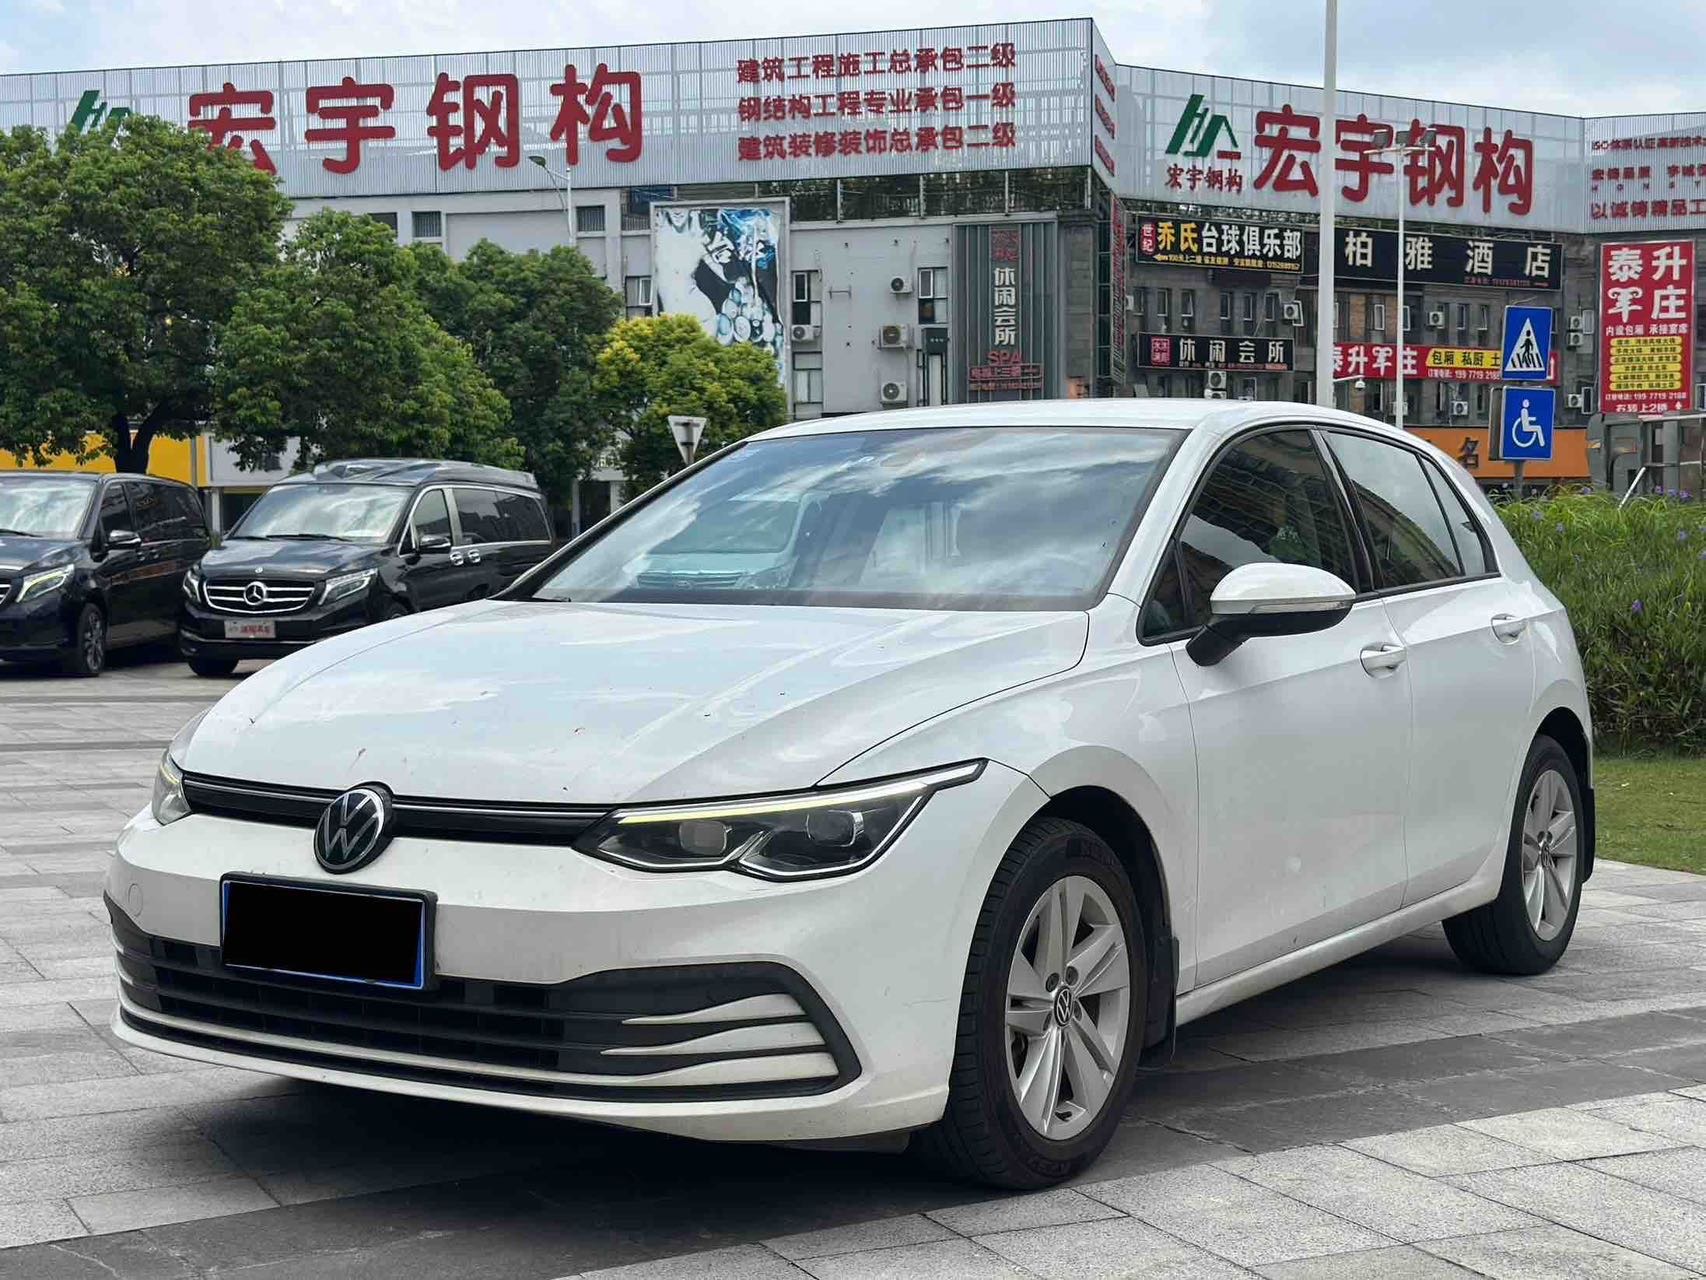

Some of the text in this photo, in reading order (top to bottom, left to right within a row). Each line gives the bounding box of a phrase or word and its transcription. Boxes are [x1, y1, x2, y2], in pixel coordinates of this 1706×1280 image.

[736, 41, 1016, 84] 建筑工程施工总承包二级
[188, 63, 642, 176] 宏宇钢构
[737, 82, 1016, 123] 钢结构工程专业承包一级
[737, 121, 1016, 162] 建筑装修装饰总承包二级
[1254, 104, 1534, 215] 宏宇钢构
[1157, 221, 1301, 259] 乔氏台球俱乐部
[1344, 231, 1551, 278] 柏雅酒店
[1607, 246, 1687, 282] 泰升
[994, 267, 1016, 346] 休闲会所
[987, 351, 1022, 364] SPA
[1179, 338, 1285, 364] 休闲会所
